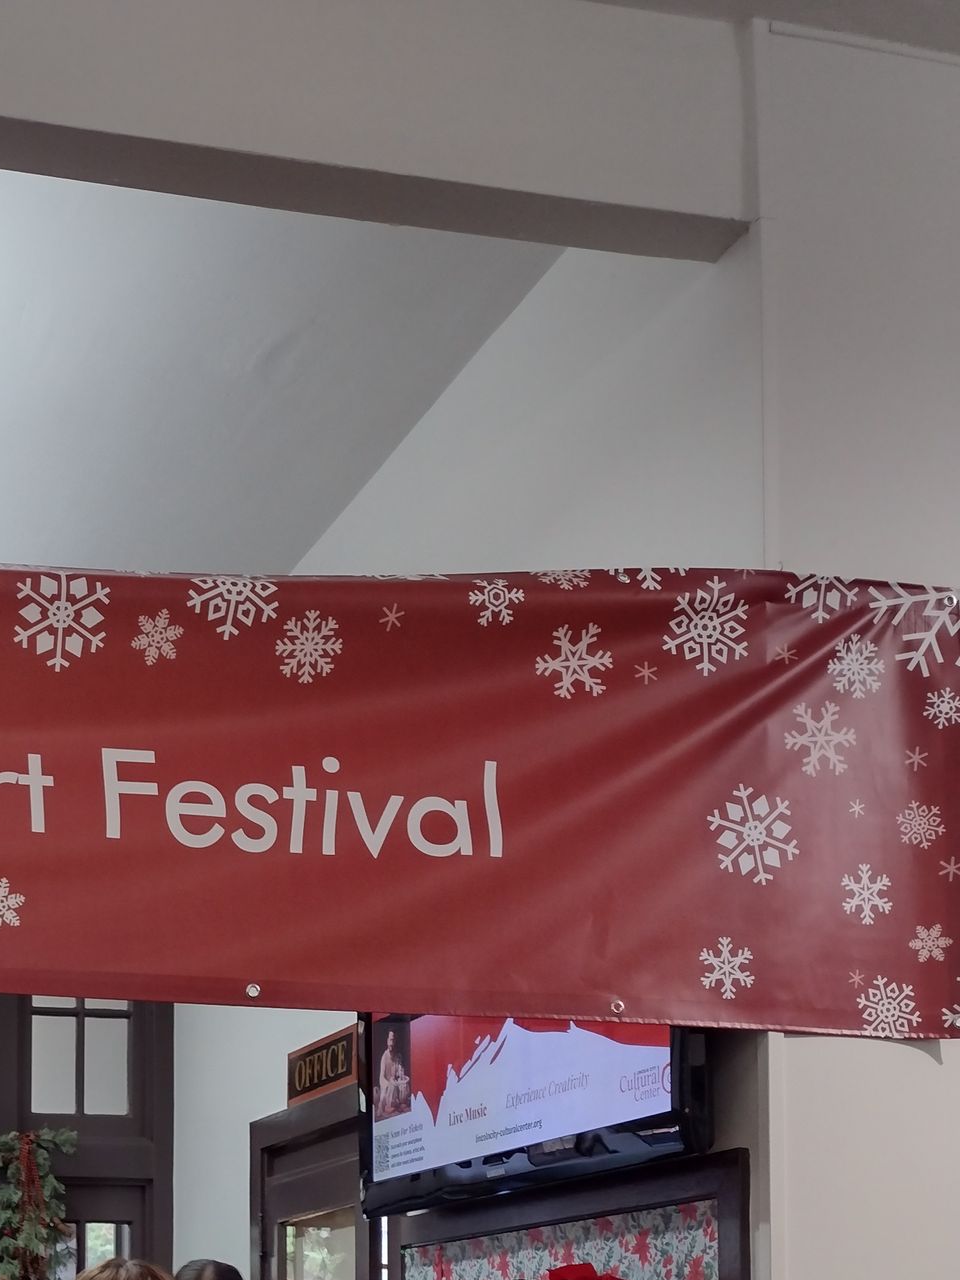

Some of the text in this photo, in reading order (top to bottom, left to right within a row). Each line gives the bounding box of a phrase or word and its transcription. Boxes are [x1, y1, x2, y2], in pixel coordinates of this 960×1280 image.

[101, 748, 503, 859] Festival
[295, 1040, 347, 1091] OFFICE
[619, 1065, 660, 1093] Cultural
[505, 1072, 590, 1110] Experience Creativity
[634, 1087, 660, 1102] Center
[448, 1103, 488, 1126] Live Music
